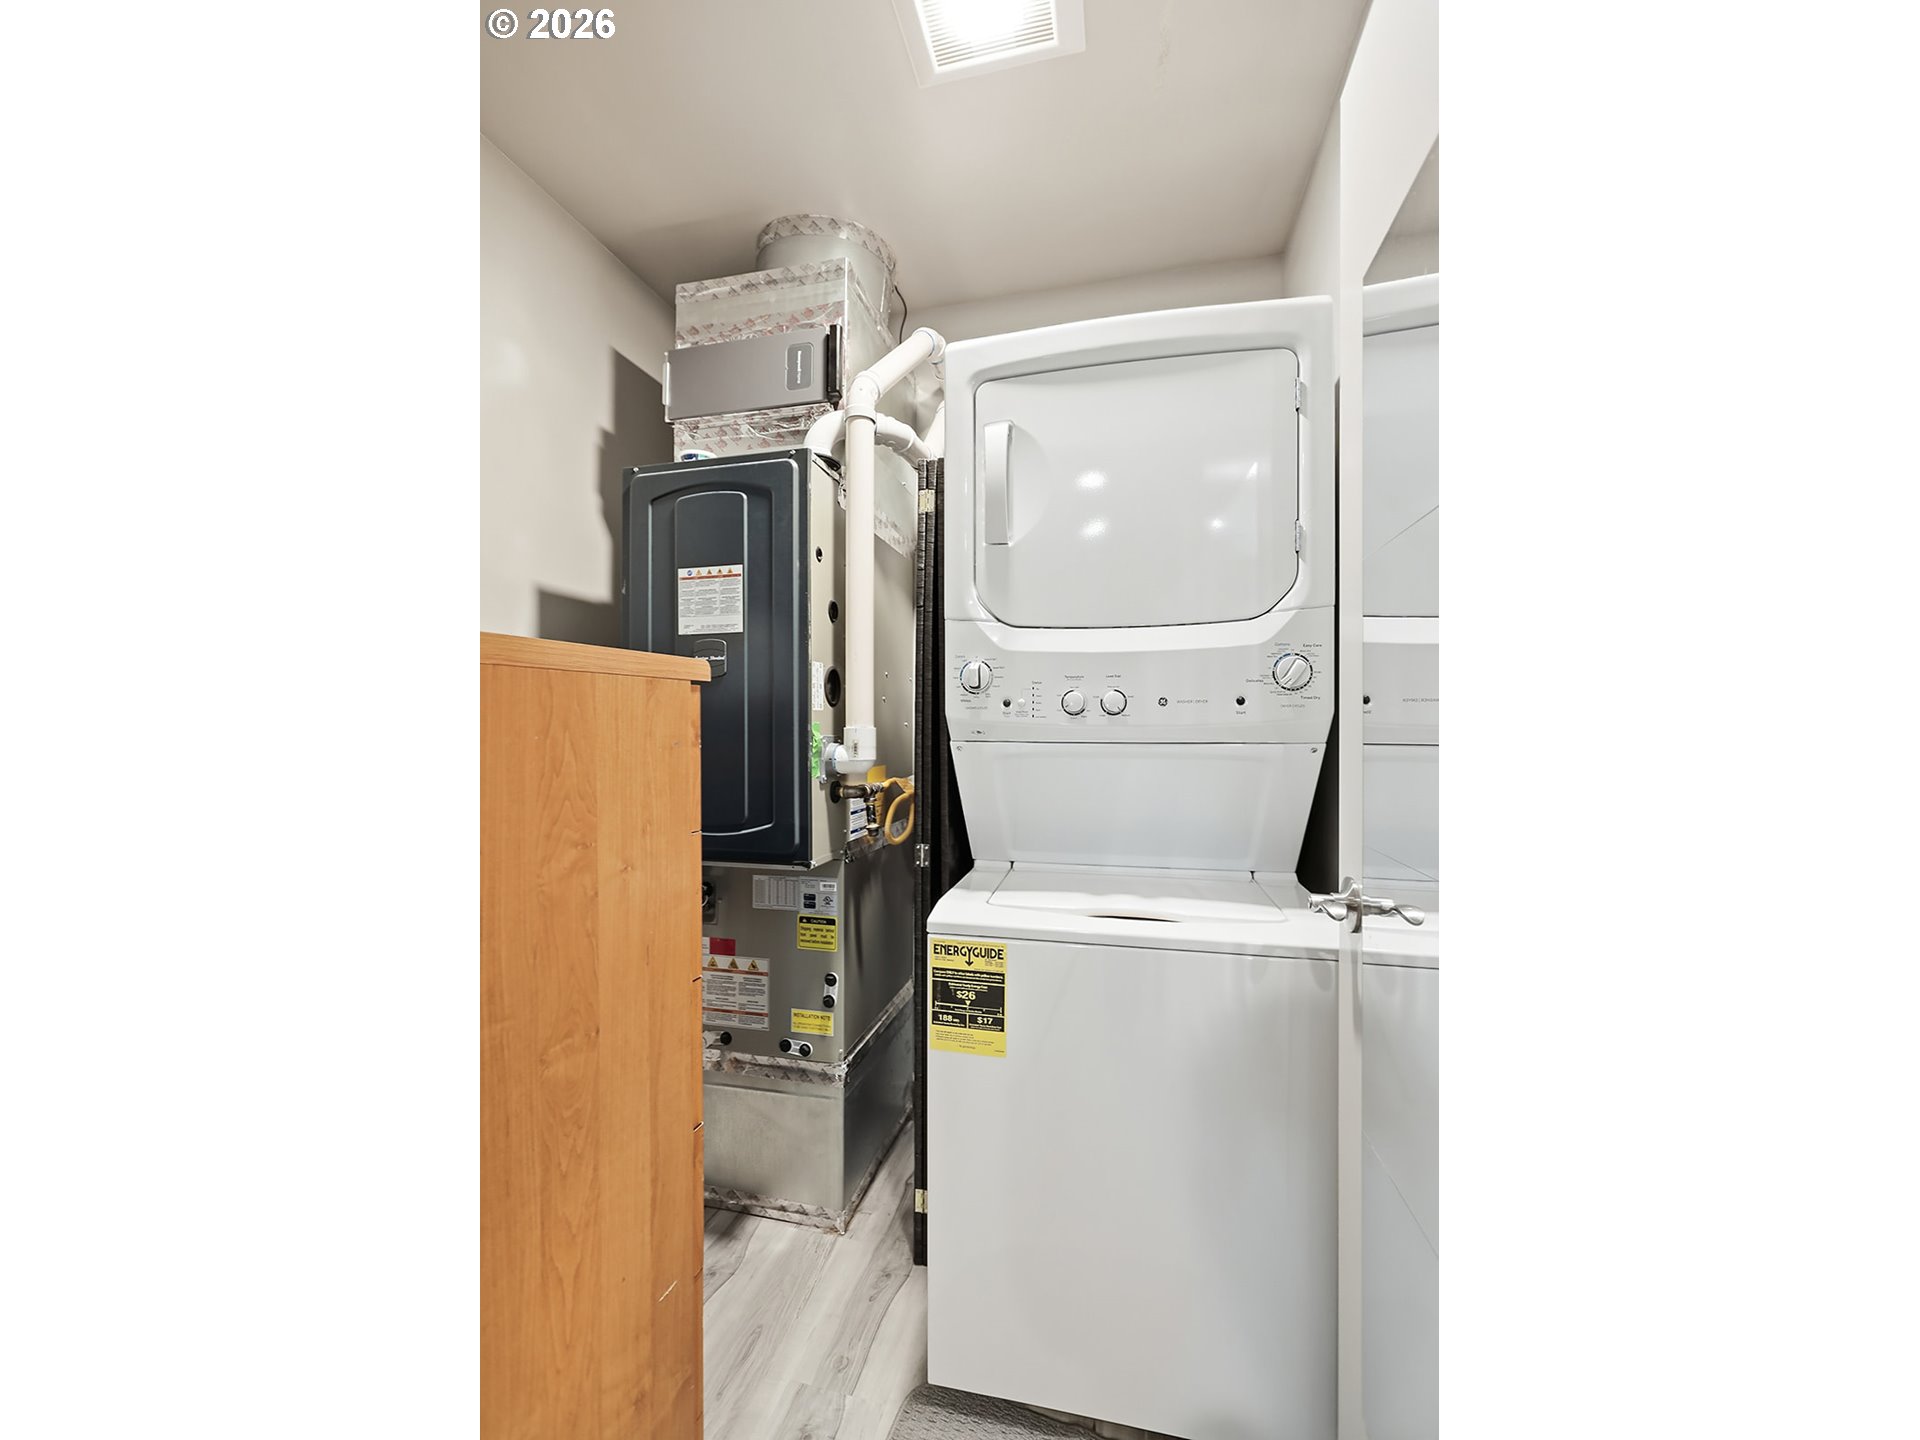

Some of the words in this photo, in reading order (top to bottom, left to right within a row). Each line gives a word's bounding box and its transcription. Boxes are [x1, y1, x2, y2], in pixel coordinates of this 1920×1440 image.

[933, 944, 1004, 960] ENERGYGUIDE
[956, 991, 976, 1000] $26
[938, 1014, 953, 1022] 188
[977, 1017, 993, 1025] $17
